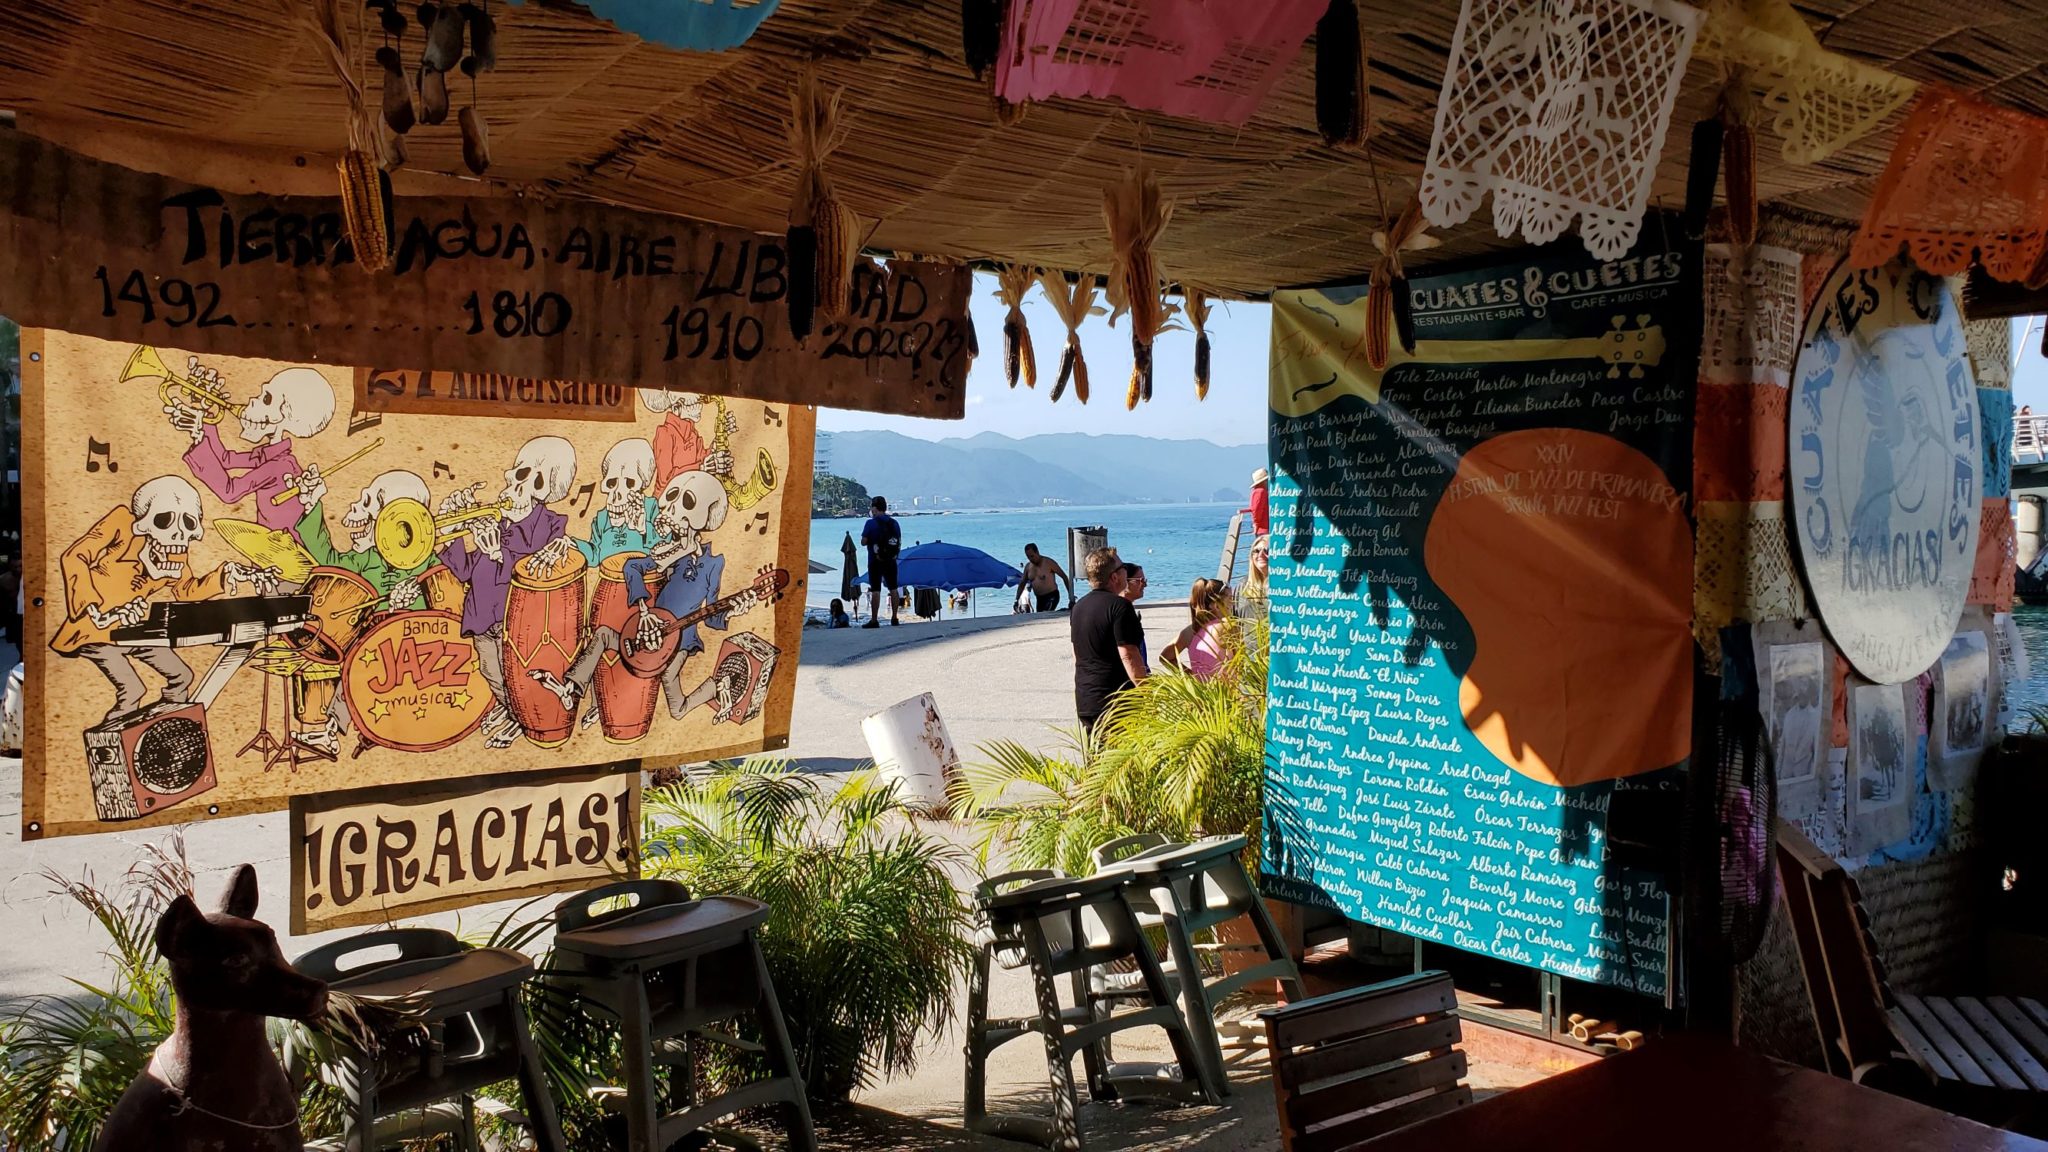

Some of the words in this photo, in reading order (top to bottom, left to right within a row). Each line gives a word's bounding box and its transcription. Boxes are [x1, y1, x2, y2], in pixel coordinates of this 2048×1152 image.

[697, 239, 928, 323] LIBTAD
[1410, 278, 1521, 311] CUATES
[1550, 252, 1682, 294] CUETES
[1267, 587, 1293, 597] auren
[402, 618, 449, 636] Banda
[367, 638, 472, 694] JAZZ
[389, 692, 454, 707] musica
[1273, 673, 1308, 689] Daniel
[1406, 687, 1441, 706] Davis
[1416, 708, 1449, 730] Reyes
[1410, 732, 1462, 752] Andrade
